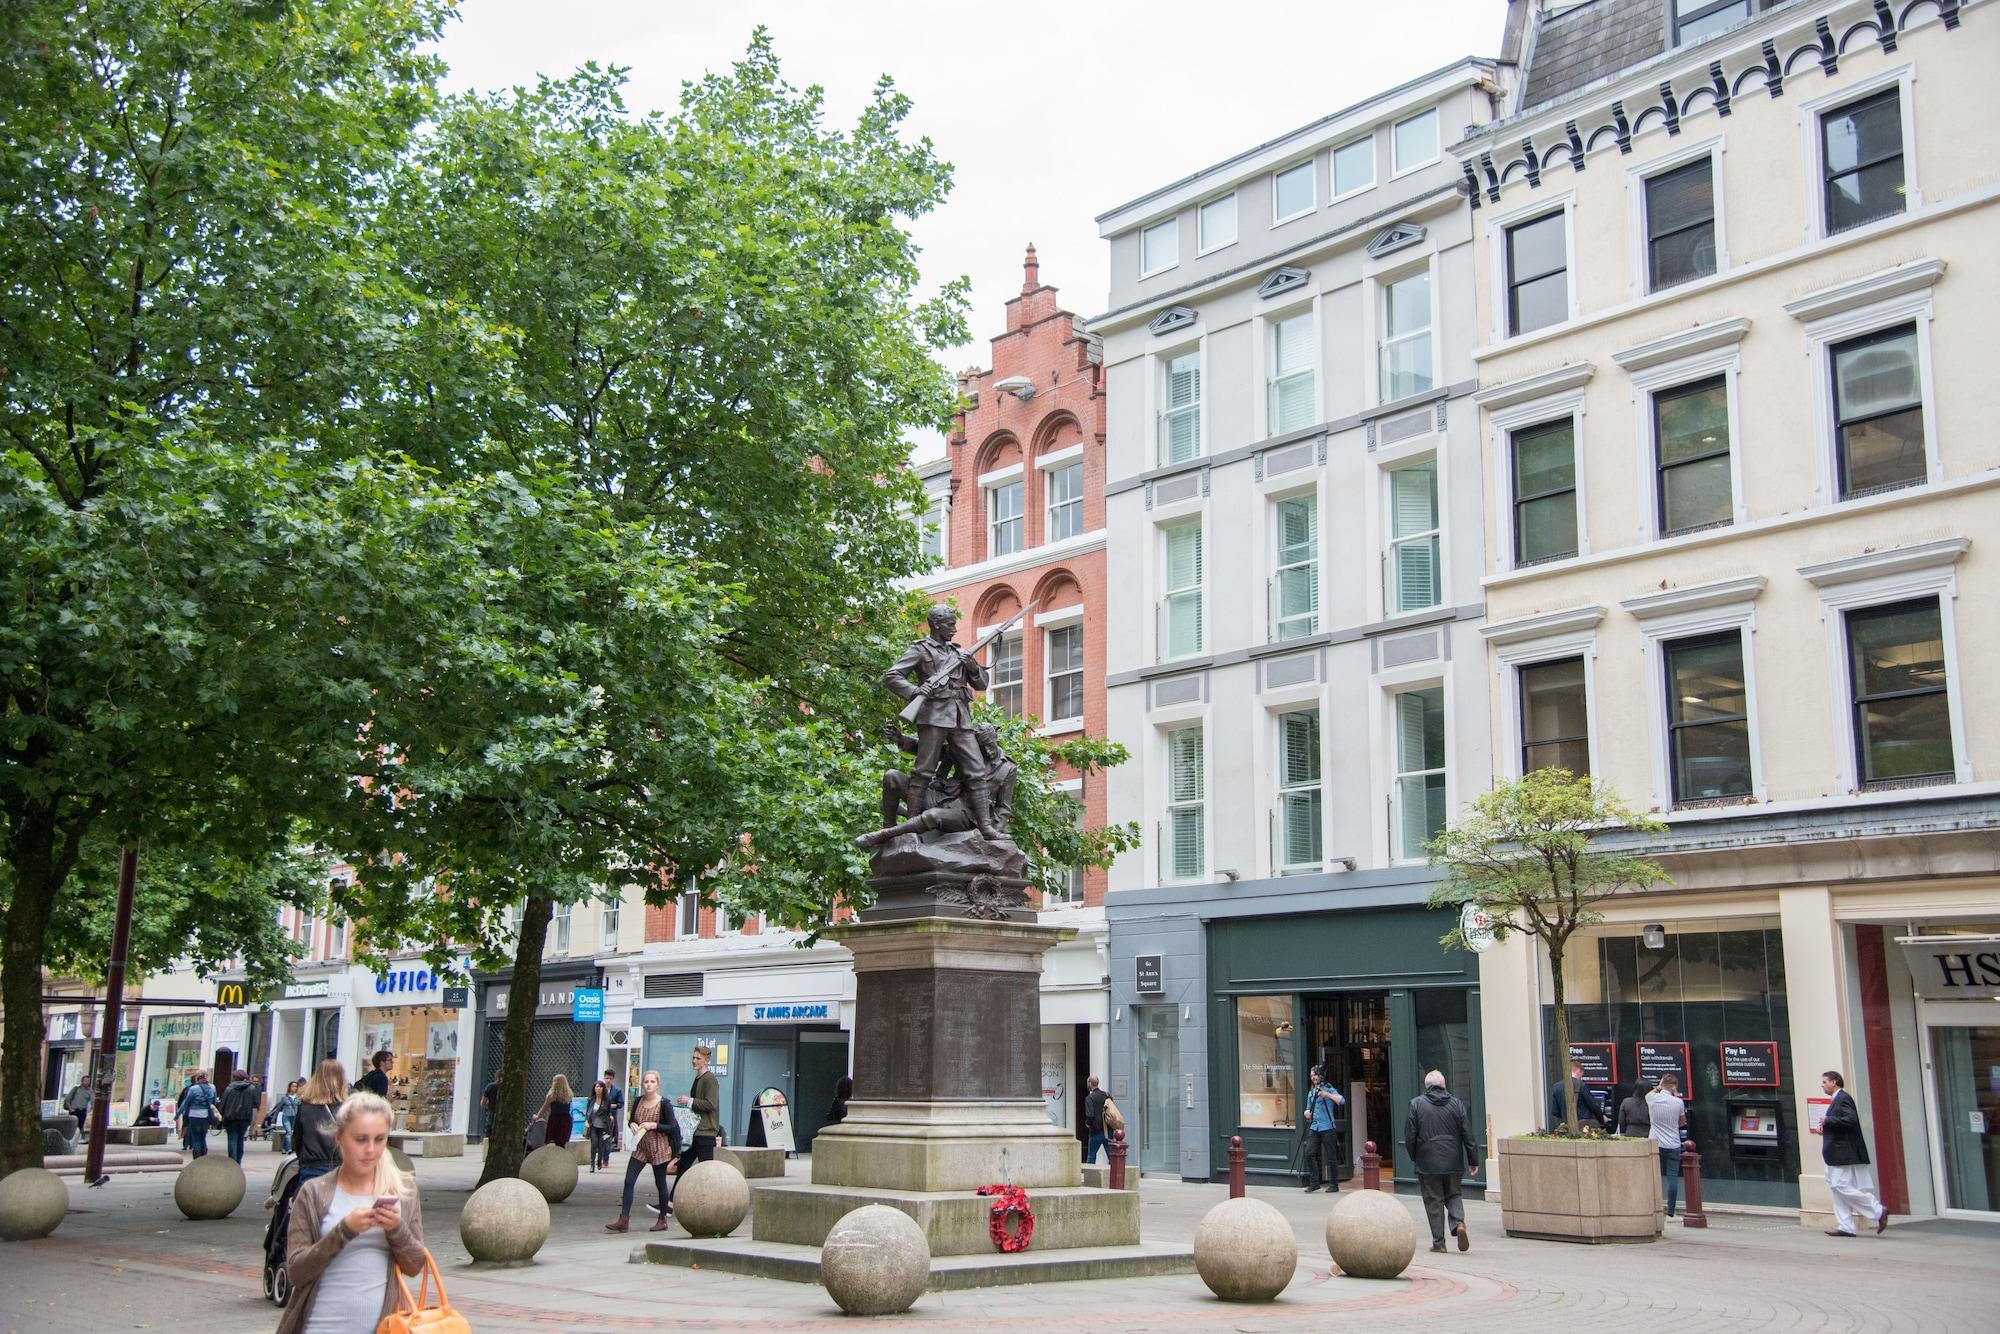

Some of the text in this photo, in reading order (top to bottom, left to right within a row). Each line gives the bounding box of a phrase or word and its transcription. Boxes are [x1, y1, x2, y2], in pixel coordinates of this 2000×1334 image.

[1932, 952, 2000, 987] HS
[375, 970, 437, 993] OFFICE
[615, 979, 623, 988] 14
[579, 994, 600, 1004] Oasis
[754, 1007, 765, 1019] ST
[791, 1005, 827, 1017] ARCADE
[697, 1037, 716, 1048] To Let
[1640, 1046, 1655, 1054] Free
[1725, 1047, 1738, 1056] Pay
[1041, 1062, 1064, 1070] MING
[1042, 1070, 1059, 1078] OON
